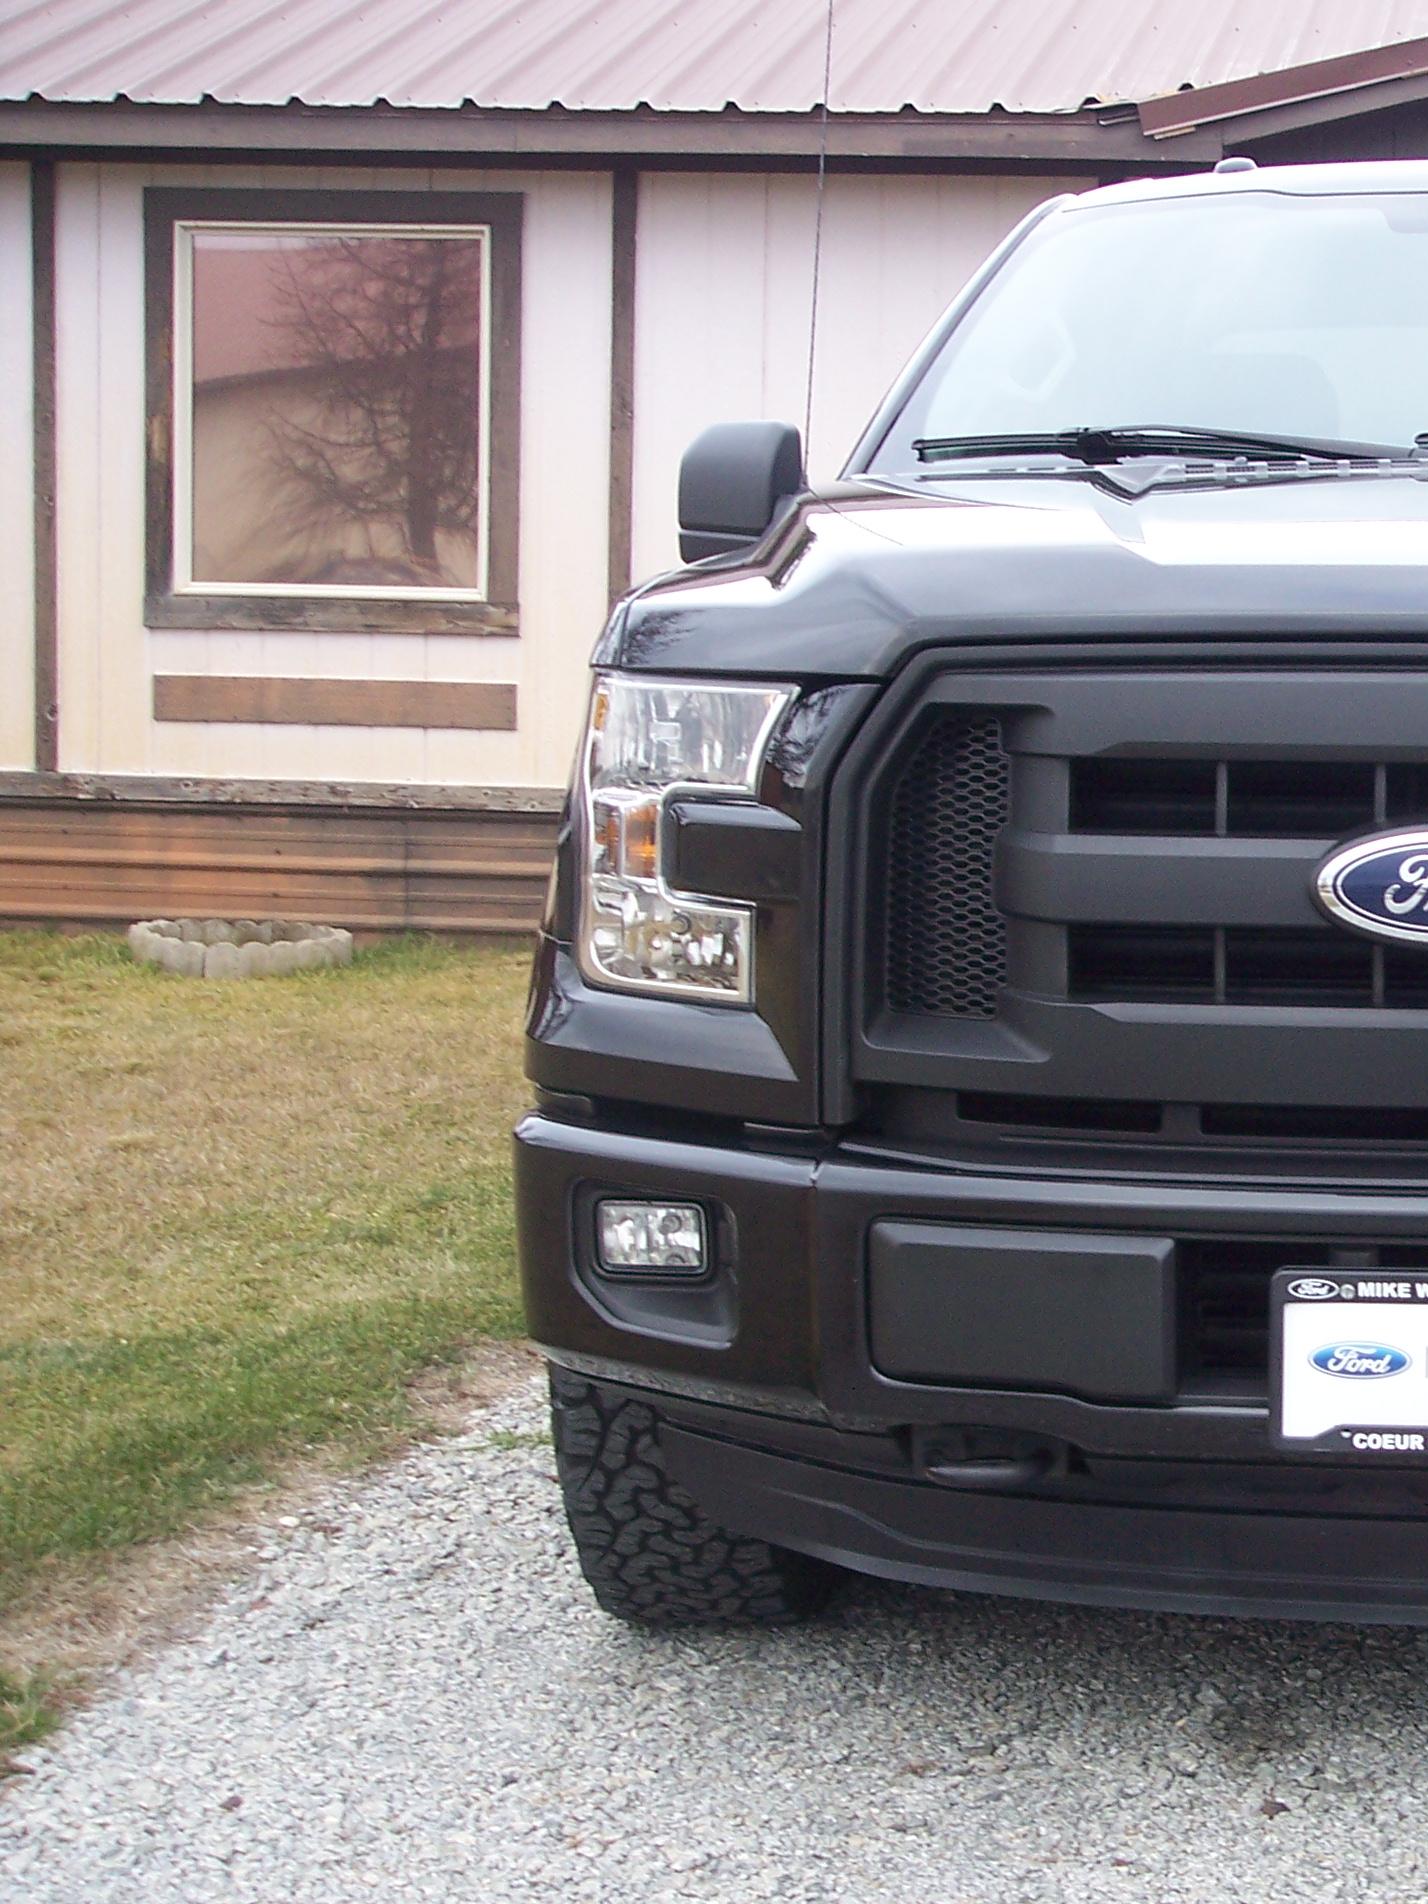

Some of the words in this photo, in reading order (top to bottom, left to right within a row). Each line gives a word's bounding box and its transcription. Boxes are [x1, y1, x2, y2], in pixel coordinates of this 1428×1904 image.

[1357, 1282, 1412, 1298] MIKE
[1327, 1346, 1392, 1375] Ford
[1352, 1432, 1424, 1451] COEUR
